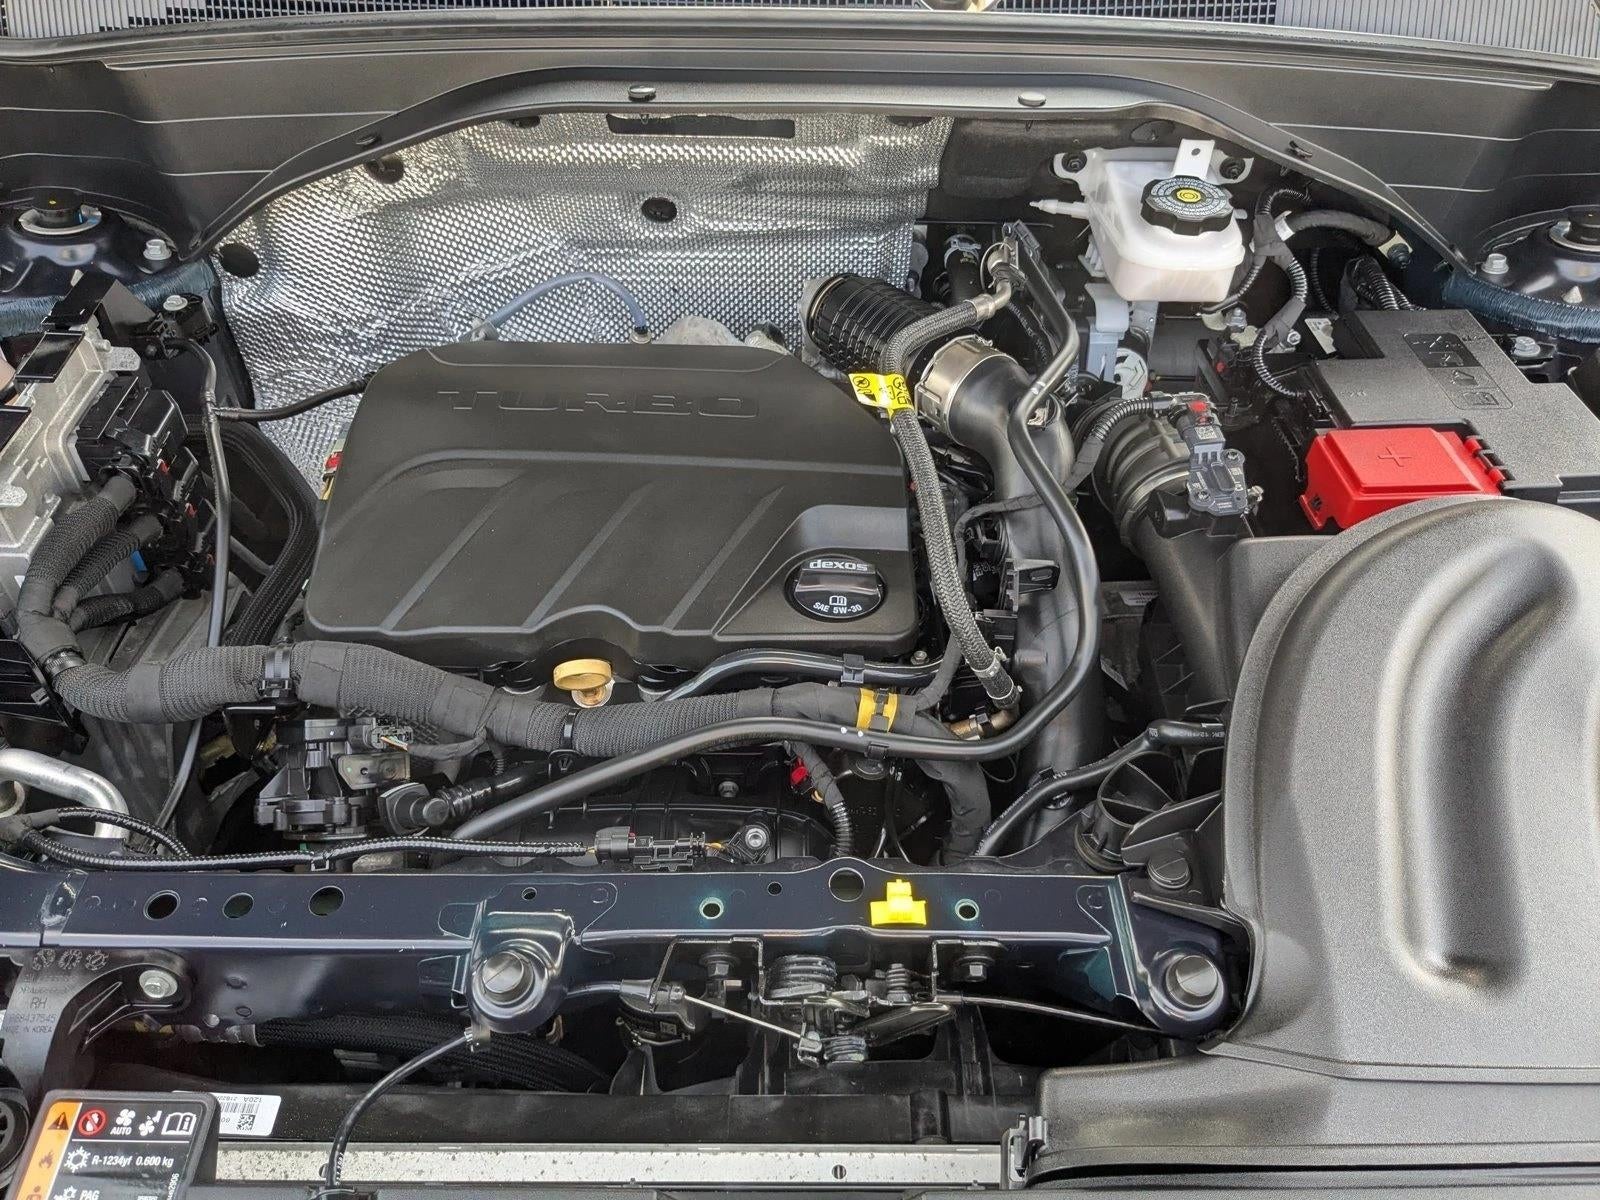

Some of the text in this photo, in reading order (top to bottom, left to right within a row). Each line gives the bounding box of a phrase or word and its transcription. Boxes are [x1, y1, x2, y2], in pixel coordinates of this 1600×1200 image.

[436, 390, 758, 419] TURBO
[809, 559, 868, 571] dexos
[813, 602, 862, 614] SAE 5W-30
[30, 996, 48, 1009] RH
[110, 1126, 132, 1135] AUTO
[91, 1155, 175, 1168] R-1234yf 0.600 kg
[79, 1189, 100, 1200] PAG
